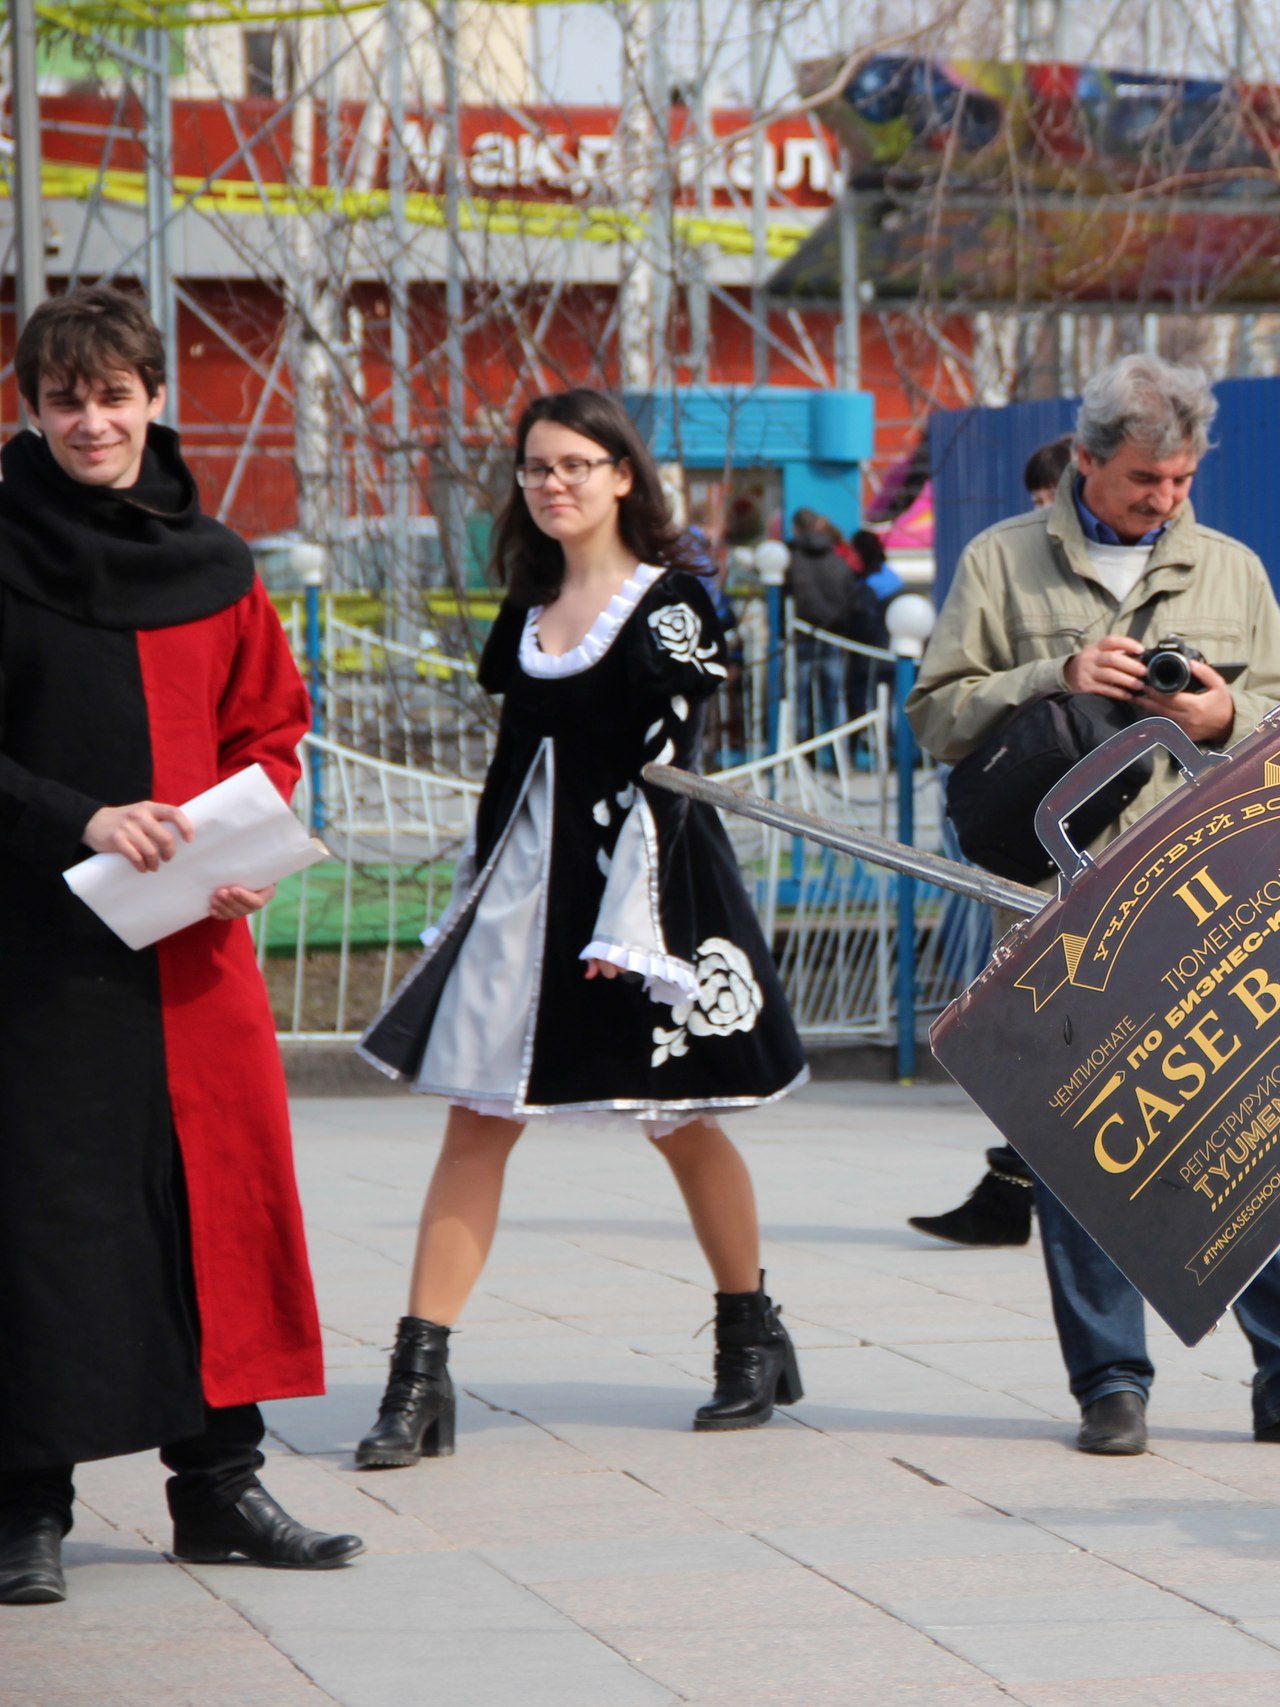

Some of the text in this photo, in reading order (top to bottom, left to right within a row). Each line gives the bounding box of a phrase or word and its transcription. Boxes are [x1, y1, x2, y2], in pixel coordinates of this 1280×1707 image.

[1093, 813, 1234, 962] УЧАСТВУЙ
[1172, 865, 1233, 927] II
[1049, 1015, 1136, 1110] ЧЕМПИОНАТЕ
[1094, 1009, 1242, 1174] CASE
[1126, 1029, 1163, 1070] ПО
